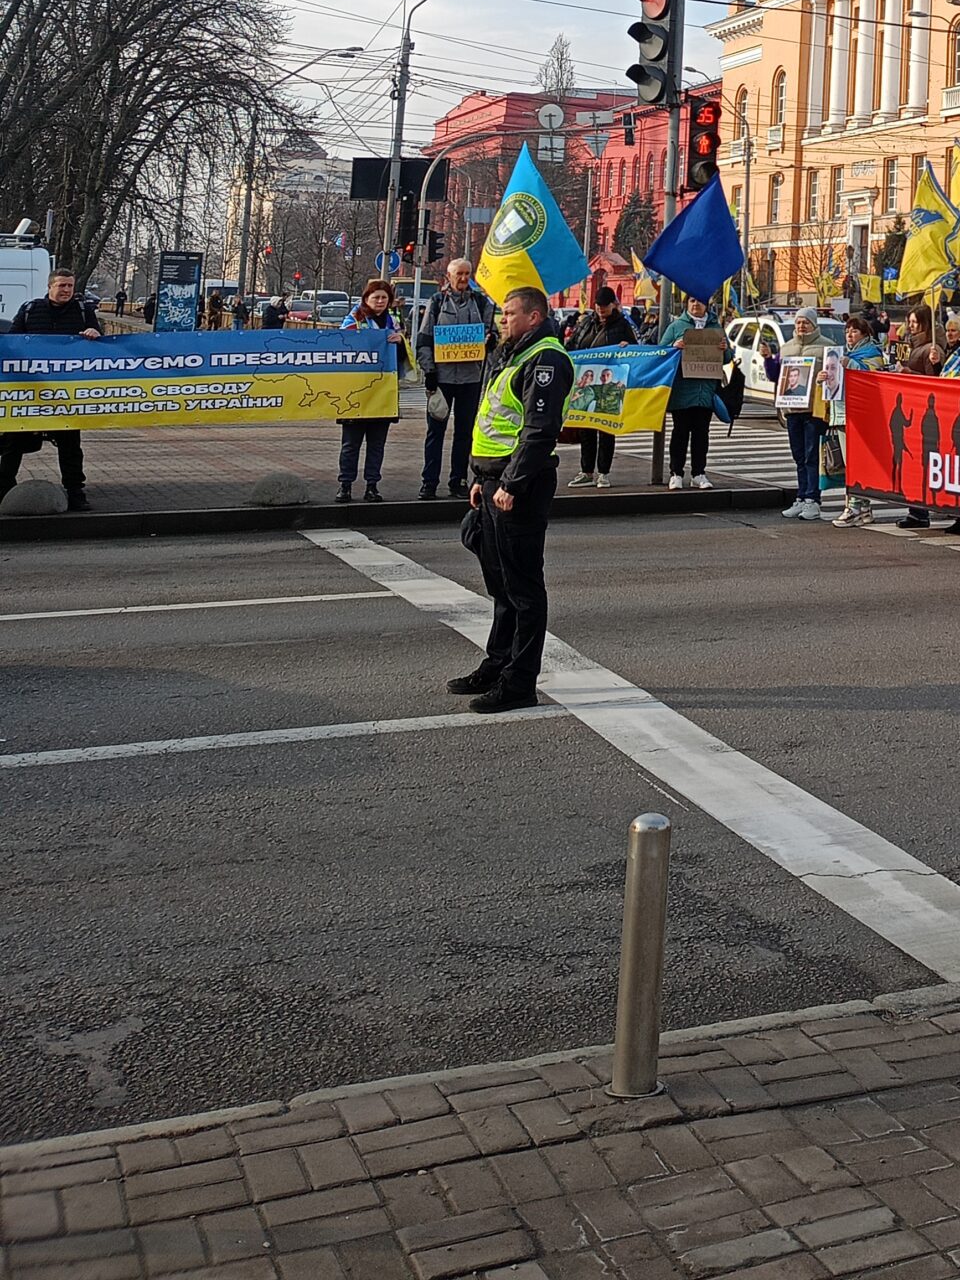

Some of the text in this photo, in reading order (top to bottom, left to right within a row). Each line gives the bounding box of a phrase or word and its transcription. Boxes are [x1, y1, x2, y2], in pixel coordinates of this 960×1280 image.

[2, 351, 379, 373] ПІДТРИМУЄМО ПРЕЗИДЕНТА!
[571, 351, 612, 360] АРНІЗОН
[0, 382, 253, 401] МИ ЗА ВОЛЮ, СВОБОДУ
[11, 402, 180, 418] НЕЗАЛЕЖНІСТЬ
[185, 395, 283, 410] УКРАЇНИ!
